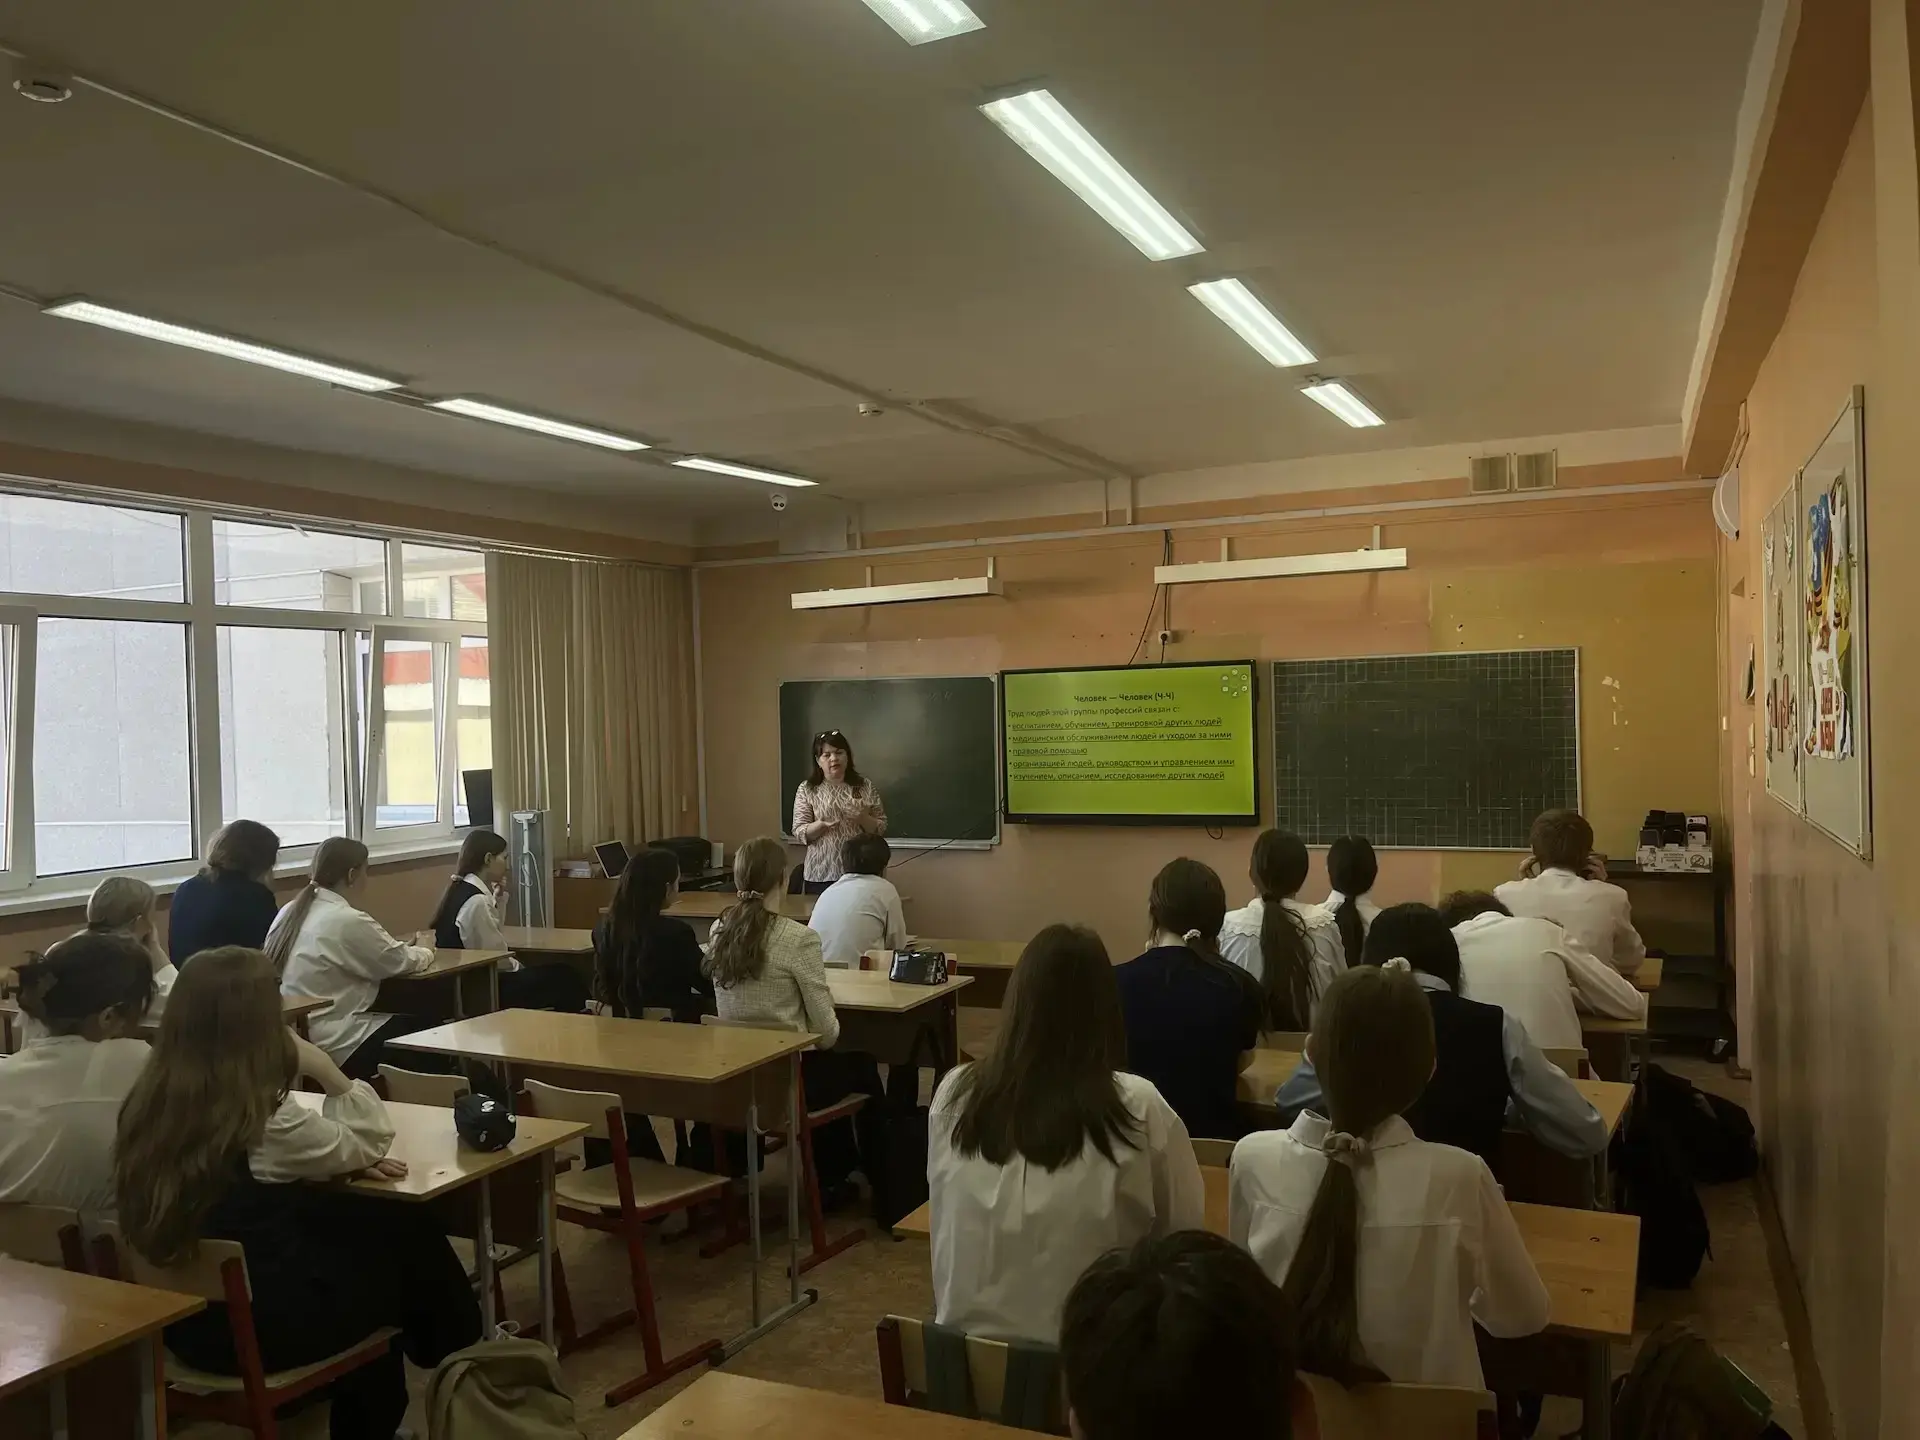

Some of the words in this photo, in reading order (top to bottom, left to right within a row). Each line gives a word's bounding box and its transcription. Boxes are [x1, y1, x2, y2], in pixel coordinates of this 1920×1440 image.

[1119, 693, 1152, 701] Человек
[1008, 710, 1024, 718] Труд
[1026, 708, 1050, 718] людей
[1070, 708, 1098, 717] группы
[1100, 706, 1142, 716] профессий
[1112, 719, 1163, 728] тренировкой
[1196, 717, 1222, 726] людей
[1066, 734, 1129, 742] обслуживанием
[1013, 748, 1048, 756] правовой
[1014, 760, 1065, 768] организацией
[1096, 760, 1151, 768] руководством
[1104, 772, 1166, 780] исследованием
[1198, 771, 1224, 780] людей
